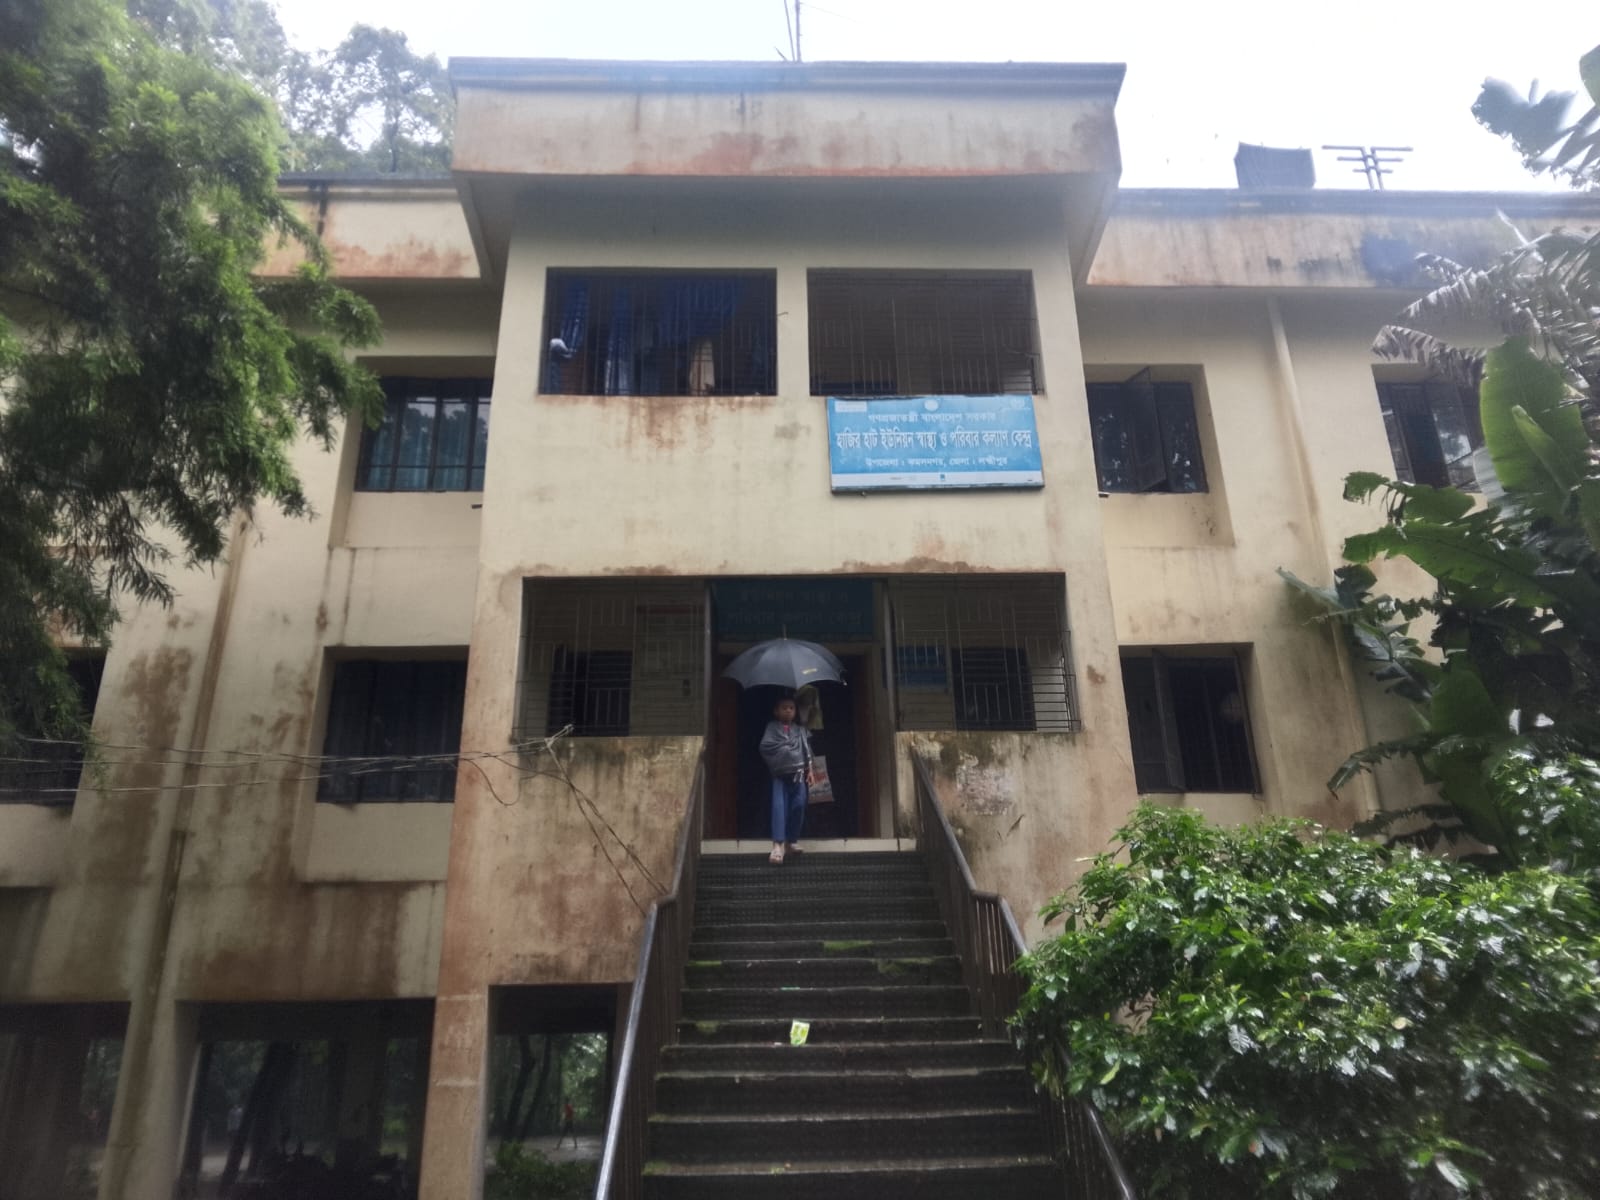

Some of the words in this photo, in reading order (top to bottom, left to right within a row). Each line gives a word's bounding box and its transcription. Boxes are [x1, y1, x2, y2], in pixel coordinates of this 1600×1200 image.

[836, 426, 861, 449] হাজির
[864, 428, 878, 449] হাট
[940, 431, 948, 448] ও
[950, 425, 980, 449] পরিবার
[982, 430, 1009, 449] কল্যাণ
[1011, 429, 1033, 449] কেন্দ্র
